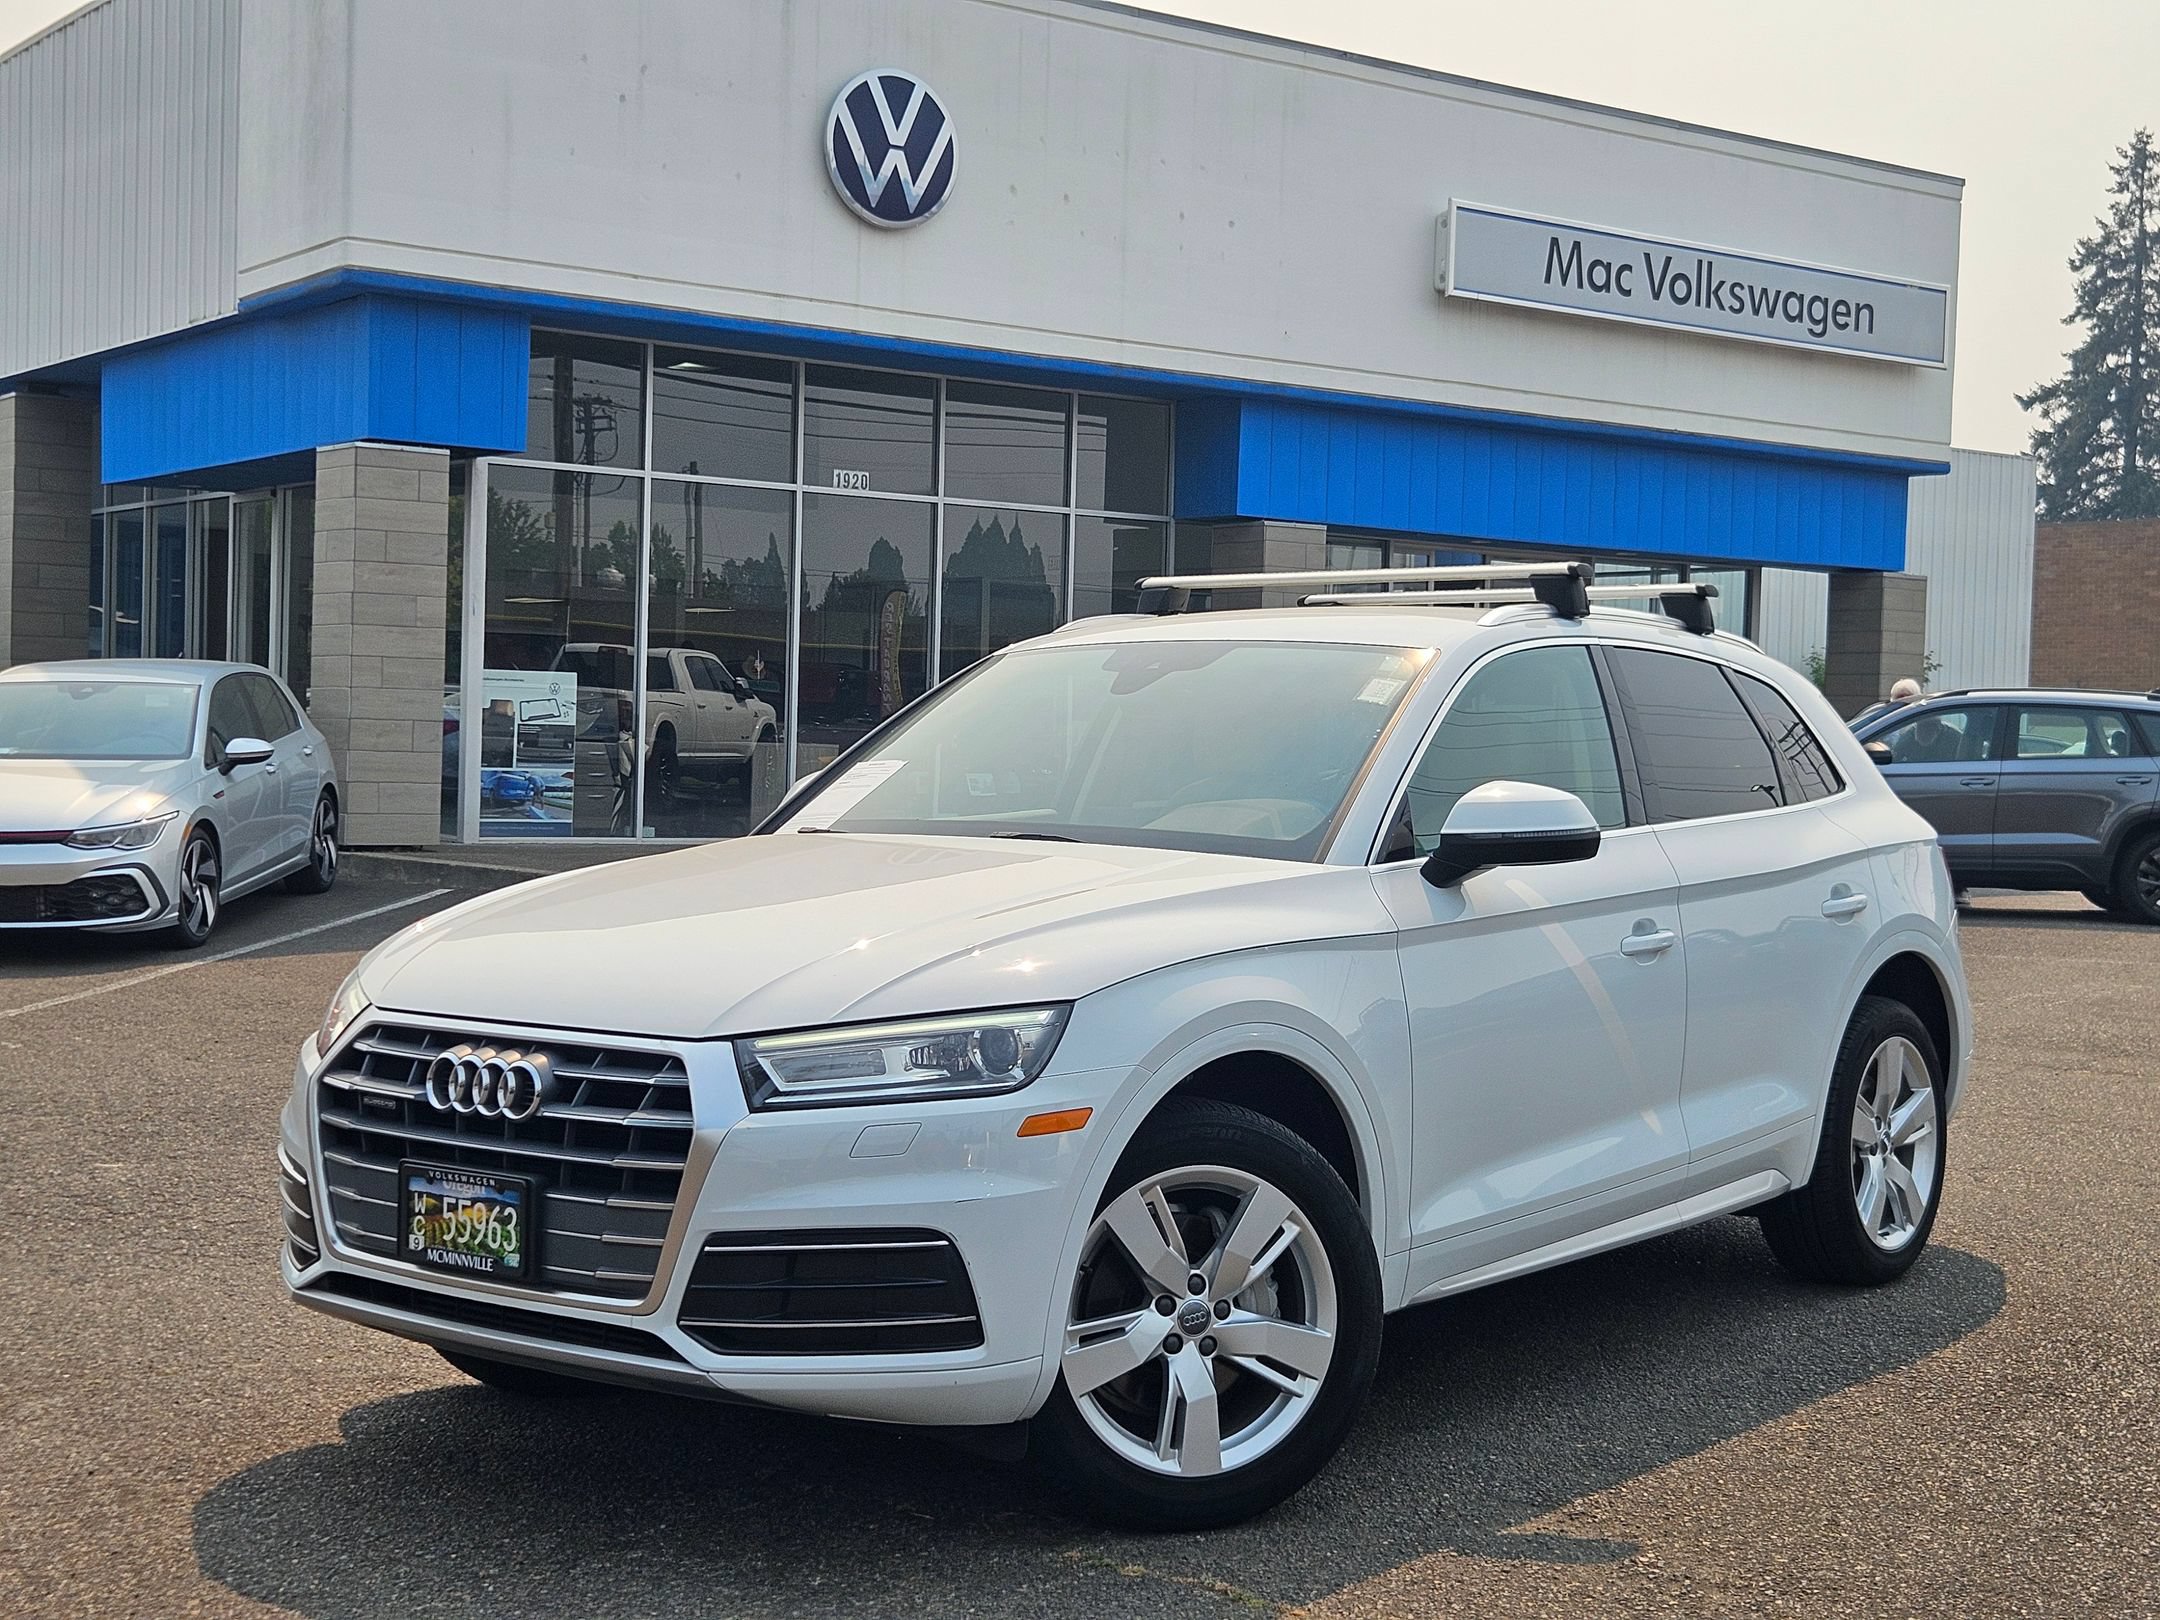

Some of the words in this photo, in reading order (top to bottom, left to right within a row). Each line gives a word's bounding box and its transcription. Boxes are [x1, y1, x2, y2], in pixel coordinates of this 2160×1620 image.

[1543, 236, 1634, 298] Mac
[1643, 252, 1876, 339] Volkswagen
[835, 472, 868, 490] 1920
[428, 1171, 496, 1186] VOLKSWAGEN
[442, 1197, 518, 1252] 55963
[412, 1237, 421, 1250] 9
[427, 1249, 494, 1272] MCMINNVILLE
